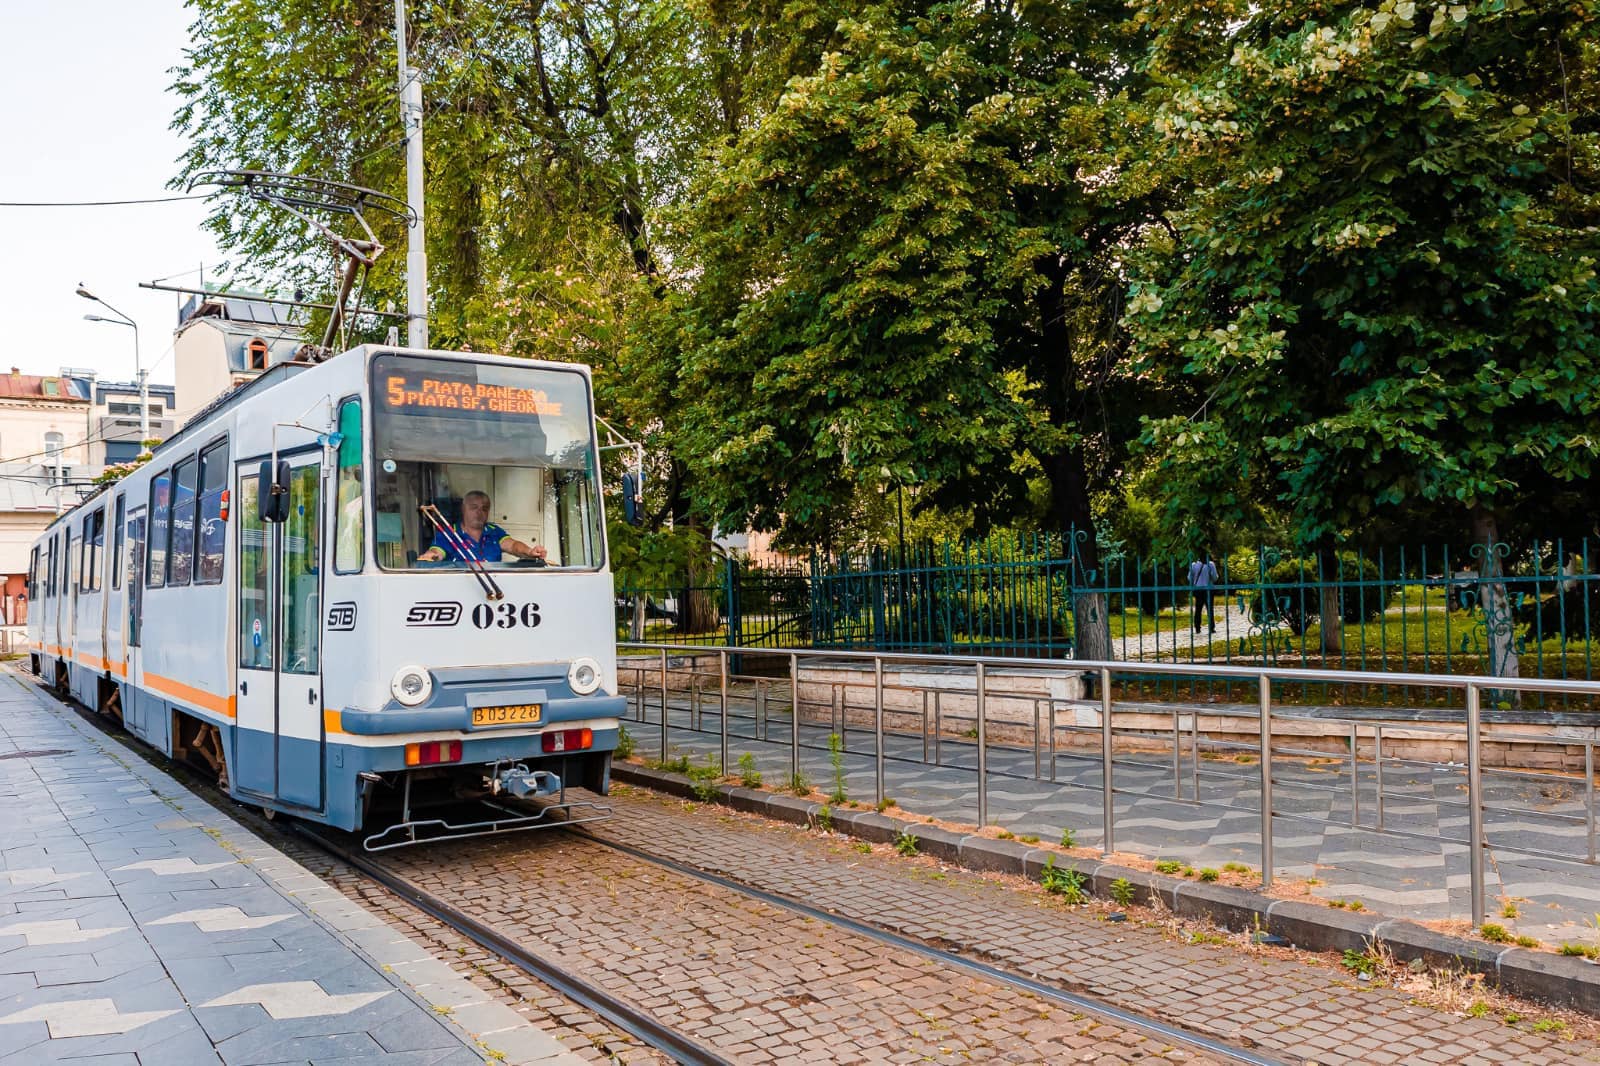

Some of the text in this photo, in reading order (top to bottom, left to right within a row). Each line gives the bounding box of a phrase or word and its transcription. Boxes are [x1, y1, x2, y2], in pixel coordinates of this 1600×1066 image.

[388, 377, 405, 405] 5
[423, 380, 473, 396] PIATA
[407, 391, 457, 408] PIATA
[461, 397, 485, 411] SF.
[328, 607, 354, 625] STB
[406, 606, 457, 622] STB
[472, 602, 541, 630] 036
